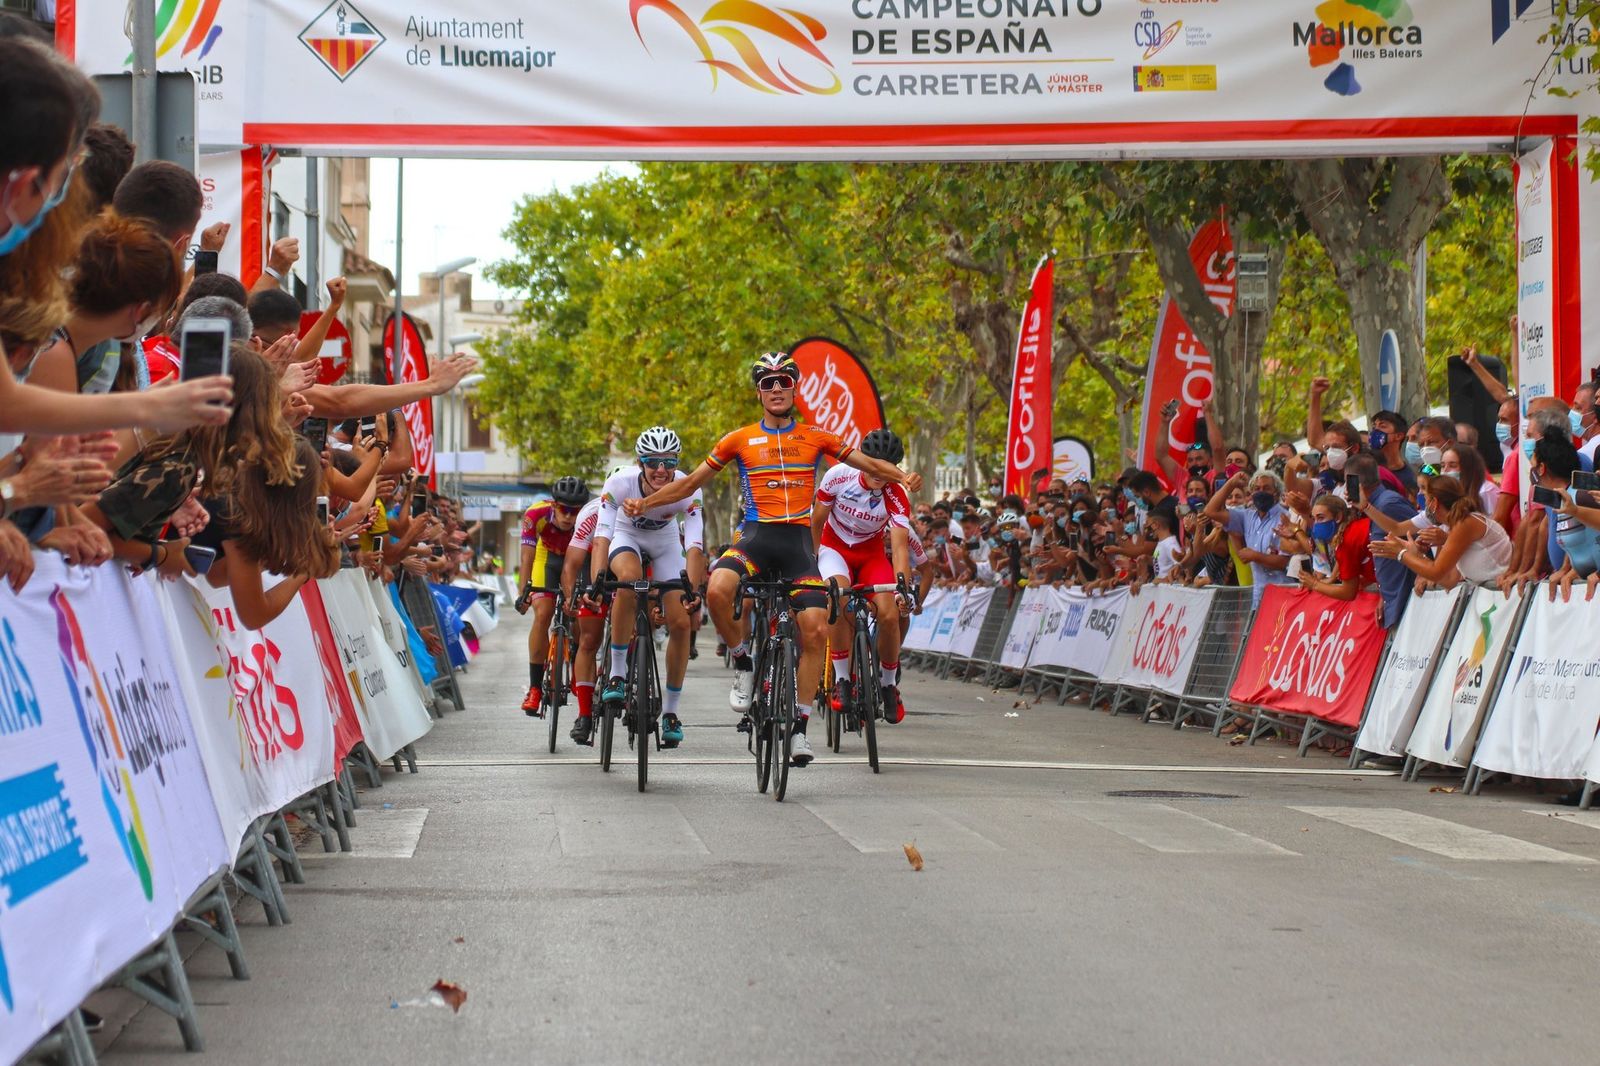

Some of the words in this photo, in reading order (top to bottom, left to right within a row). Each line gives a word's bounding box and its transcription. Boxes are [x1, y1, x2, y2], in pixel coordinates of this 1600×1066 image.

[851, 0, 1102, 19] CAMPEONATO
[405, 15, 524, 42] Ajuntament
[852, 29, 897, 54] DE
[911, 21, 1052, 54] ESPAÑA
[1134, 21, 1161, 47] CSD
[1293, 22, 1422, 47] Mallorca
[406, 44, 431, 66] de
[440, 45, 556, 72] Llucmajor
[1352, 49, 1375, 59] Illes
[1380, 48, 1422, 59] Balears
[853, 73, 1043, 96] CARRETERA
[1047, 72, 1089, 83] JÚNIOR
[1047, 85, 1054, 93] Y
[1057, 82, 1103, 93] MÁSTER
[1133, 600, 1187, 678] Cofidis
[1269, 607, 1355, 703] Cofidis
